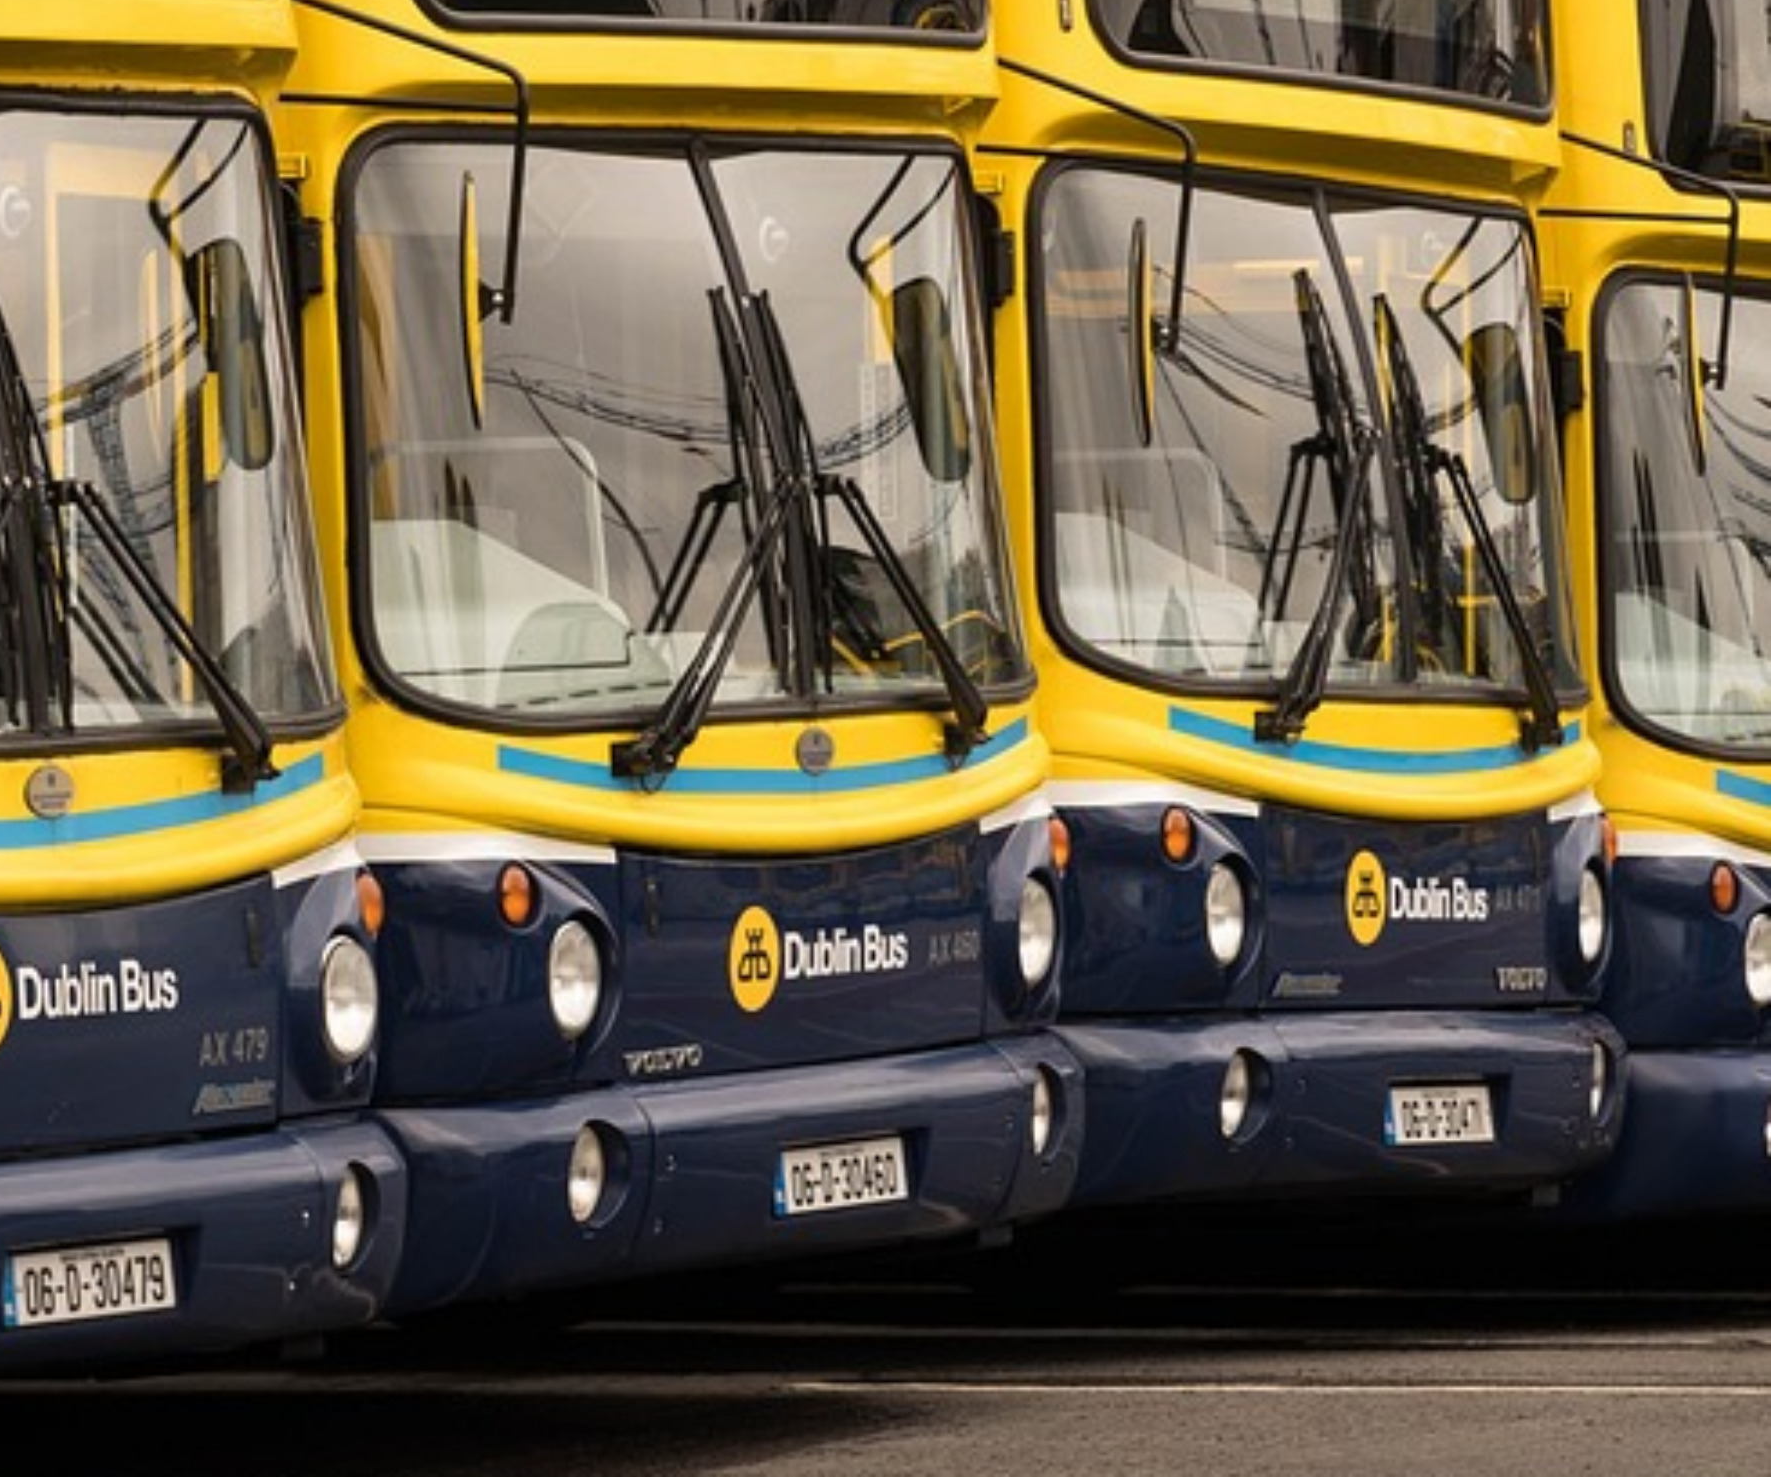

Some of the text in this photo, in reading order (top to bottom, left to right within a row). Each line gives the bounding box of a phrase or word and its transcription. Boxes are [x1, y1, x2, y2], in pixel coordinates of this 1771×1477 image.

[1390, 876, 1450, 920] Dublin
[1452, 876, 1488, 921] Bus
[784, 924, 909, 980] Dublin Bus
[16, 959, 178, 1020] Dublin Bus
[199, 1026, 270, 1067] AX 479
[23, 1252, 167, 1319] 06-D-30479
